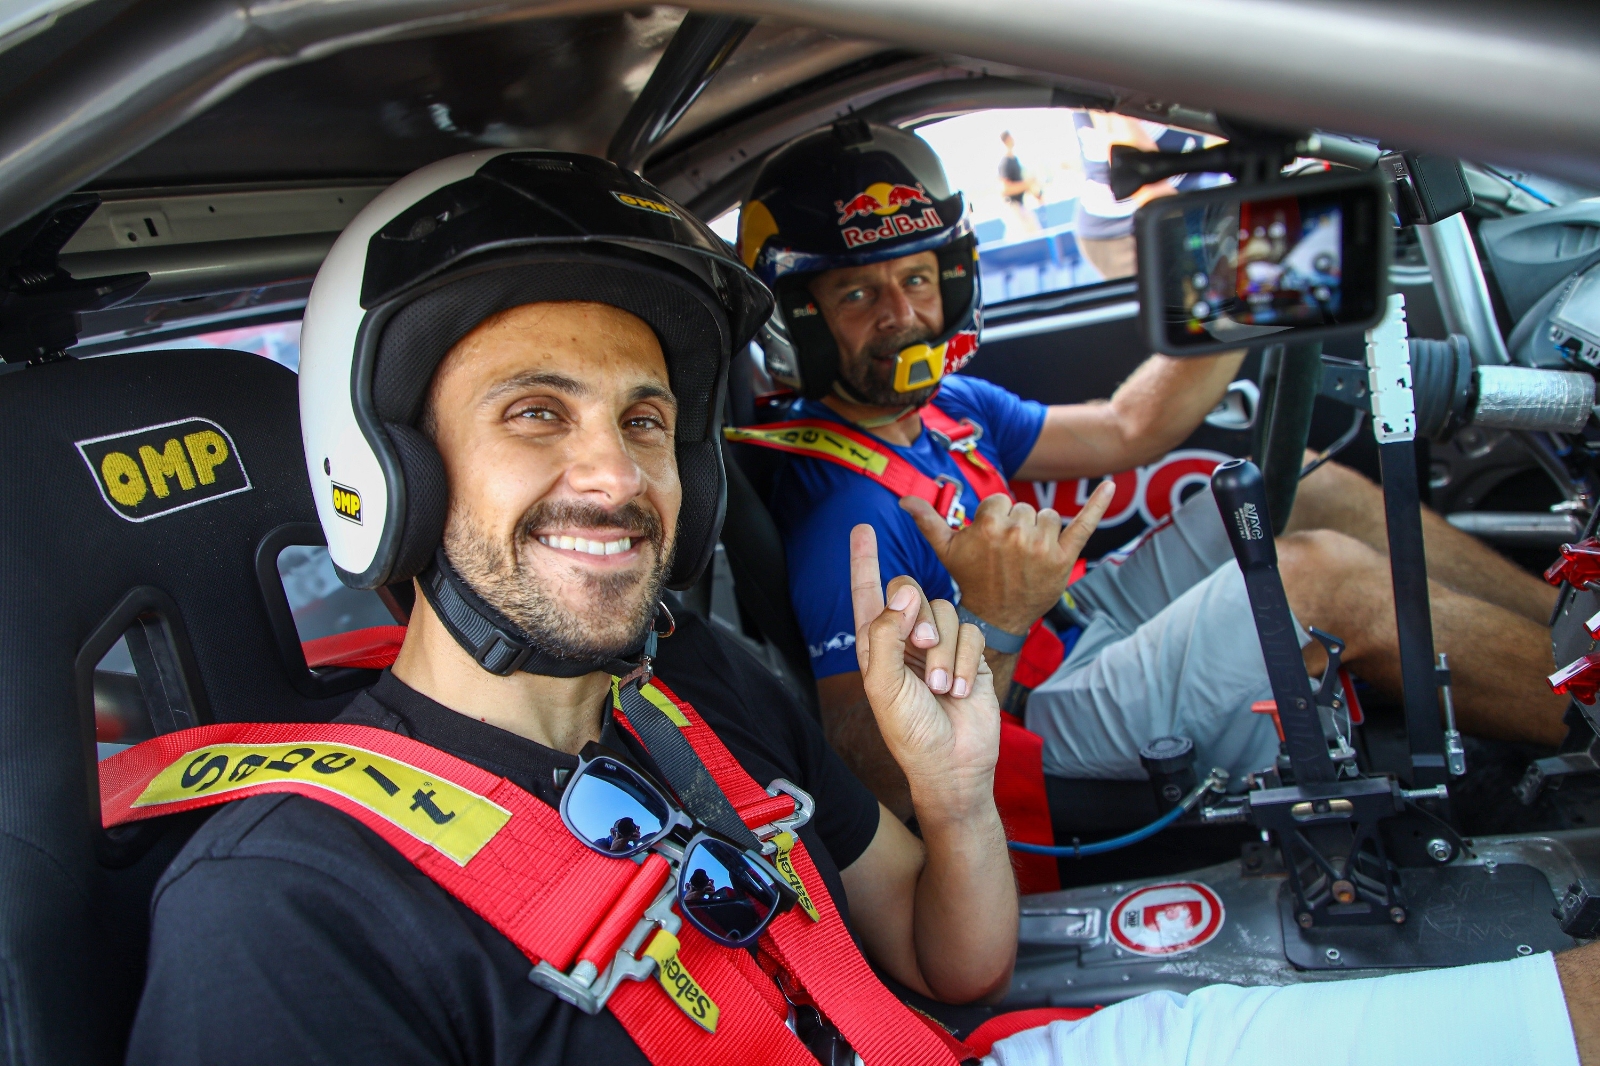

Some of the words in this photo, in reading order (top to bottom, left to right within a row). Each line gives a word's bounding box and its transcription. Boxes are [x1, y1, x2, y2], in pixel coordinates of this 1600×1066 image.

[619, 193, 672, 214] OMP
[841, 217, 897, 248] Red
[893, 207, 943, 239] Bull
[101, 430, 229, 507] OMP
[333, 488, 361, 517] OMP
[181, 747, 456, 826] Sabelt
[777, 847, 814, 910] Sabelt
